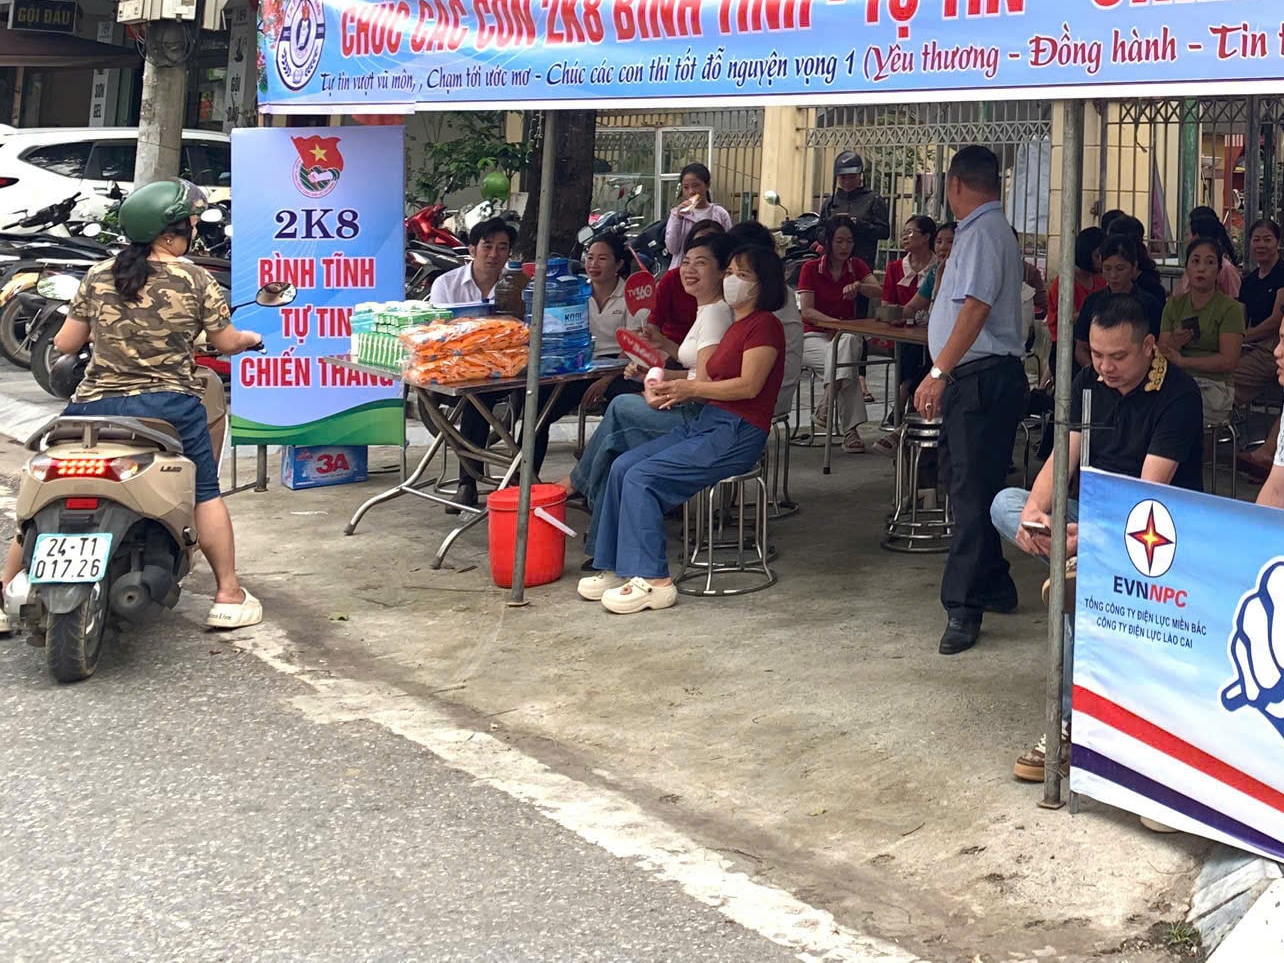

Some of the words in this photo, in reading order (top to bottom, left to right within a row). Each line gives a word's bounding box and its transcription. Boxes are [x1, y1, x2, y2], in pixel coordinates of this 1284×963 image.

[338, 71, 350, 92] tin
[352, 71, 375, 96] vượt
[427, 67, 462, 94] Chạm
[466, 64, 481, 88] tới
[485, 65, 508, 87] ước
[511, 68, 531, 87] mơ
[546, 54, 585, 86] Chúc
[590, 57, 614, 84] các
[618, 64, 643, 84] con
[649, 55, 670, 83] thi
[674, 47, 698, 81] tốt
[701, 47, 725, 81] đỗ
[727, 50, 788, 89] nguyện
[795, 54, 837, 86] vọng
[845, 50, 855, 76] 1
[864, 42, 914, 81] (Yêu
[921, 39, 999, 78] thương
[1029, 22, 1101, 74] Đồng
[1111, 26, 1178, 63] hành
[1209, 22, 1267, 60] Tin
[275, 208, 359, 239] 2K8
[259, 252, 314, 287] BÌNH
[322, 253, 374, 287] TĨNH
[281, 305, 312, 343] TỰ
[316, 308, 352, 337] TIN
[240, 347, 310, 387] CHIẾN
[316, 453, 350, 474] 3A
[46, 537, 97, 557] 24-T1
[35, 558, 101, 579] 017.26
[1113, 575, 1187, 608] EVNNPC
[1085, 595, 1104, 612] TỔNG
[1105, 602, 1125, 617] CÔNG
[1127, 608, 1136, 617] TY
[1137, 610, 1154, 625] ĐIỆN
[1155, 613, 1170, 628] LỰC
[1172, 618, 1189, 632] MIỀN
[1191, 620, 1207, 636] BẮC
[1096, 616, 1117, 631] CÔNG
[1118, 622, 1127, 633] TY
[1128, 624, 1145, 639] ĐIỆN
[1146, 629, 1161, 642] LỰC
[1180, 637, 1193, 648] CAI
